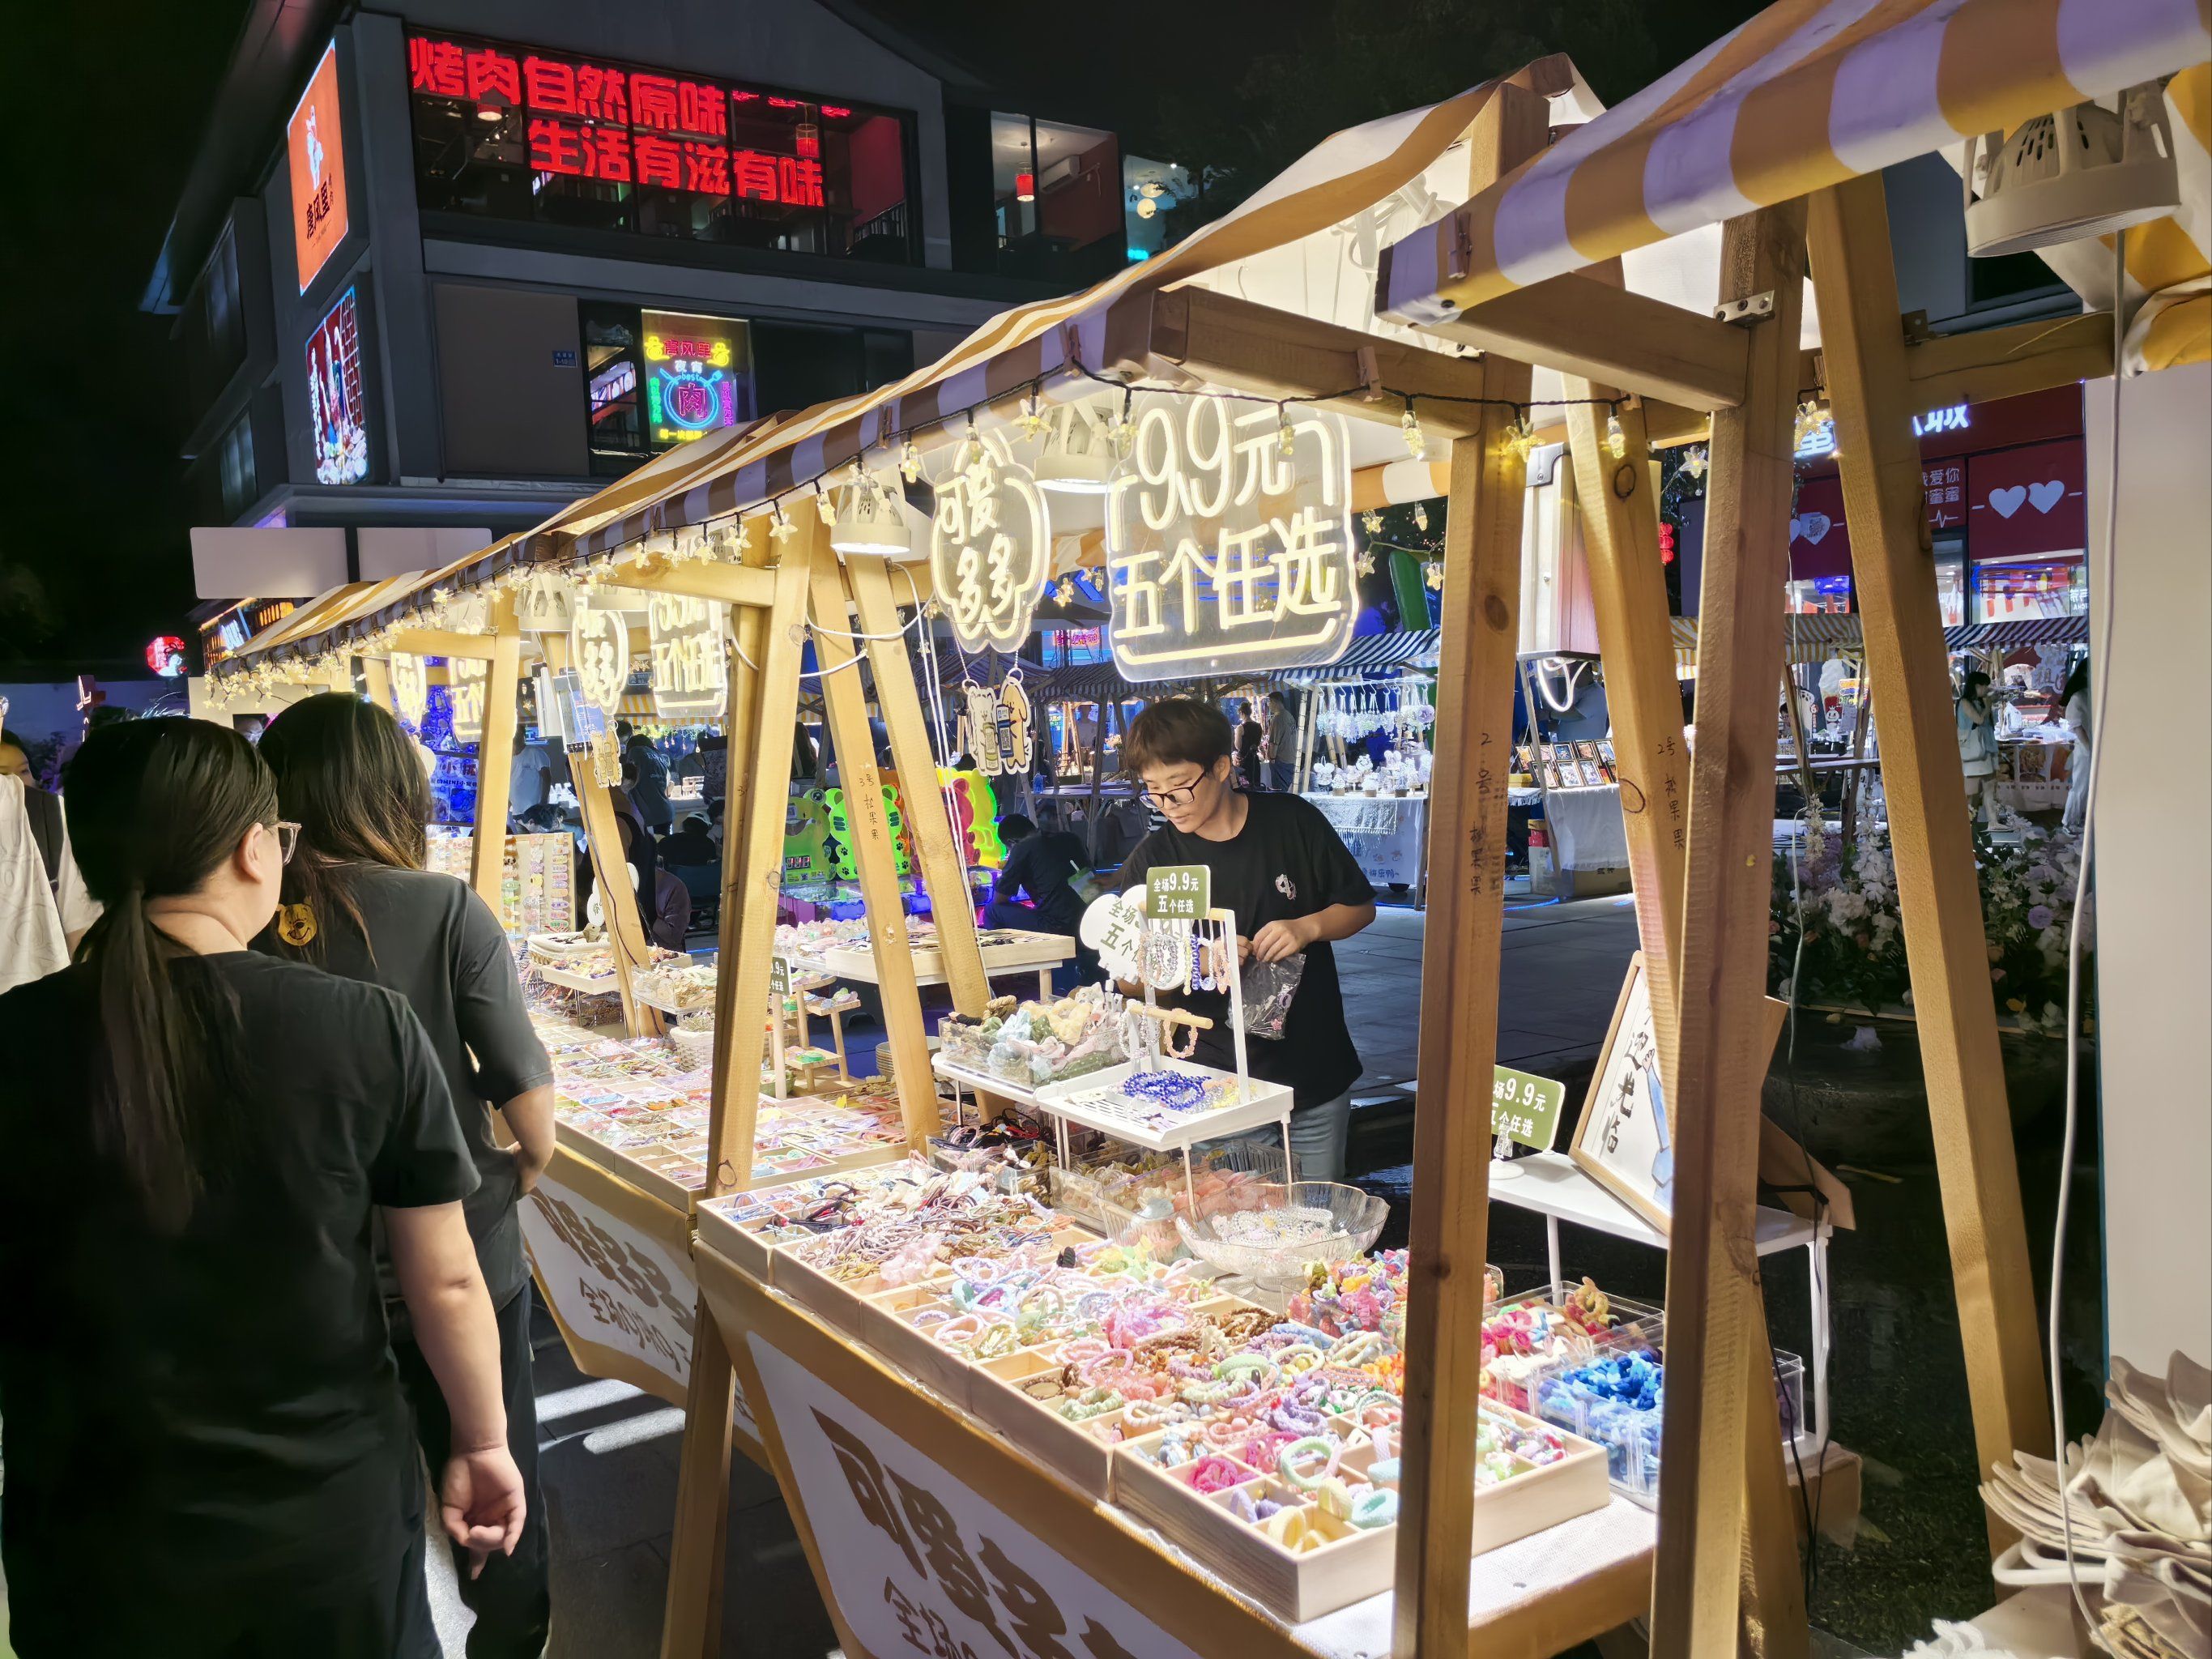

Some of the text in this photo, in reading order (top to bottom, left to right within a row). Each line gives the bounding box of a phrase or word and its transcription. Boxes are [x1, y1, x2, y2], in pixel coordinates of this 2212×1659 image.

[409, 36, 727, 137] 烤肉自然原味
[527, 117, 825, 207] 生活有滋有味
[1925, 486, 1960, 506] 蜜蜜
[1110, 506, 1342, 639] 五个任选
[1153, 872, 1200, 892] 全场9.9元
[1157, 894, 1195, 914] 五个任选
[884, 1576, 978, 1659] 全场
